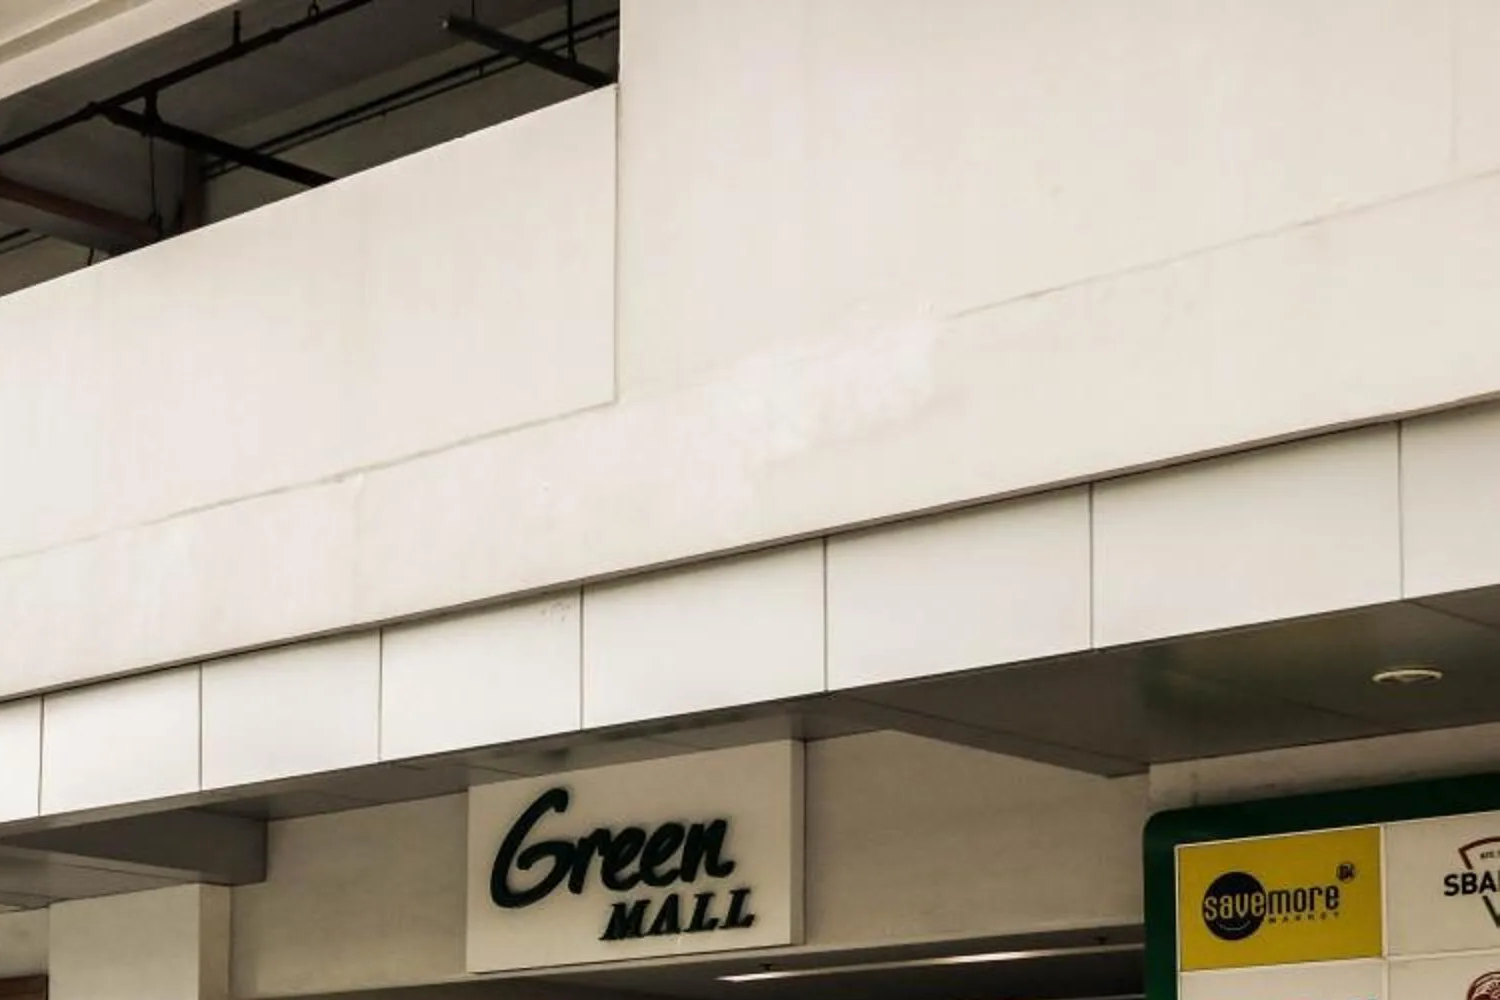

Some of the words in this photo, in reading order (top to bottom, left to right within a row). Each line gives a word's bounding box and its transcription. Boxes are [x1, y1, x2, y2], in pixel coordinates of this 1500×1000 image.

[490, 788, 735, 908] Green
[1204, 884, 1339, 921] savemore
[1443, 870, 1500, 896] SBA
[598, 887, 756, 941] MALL
